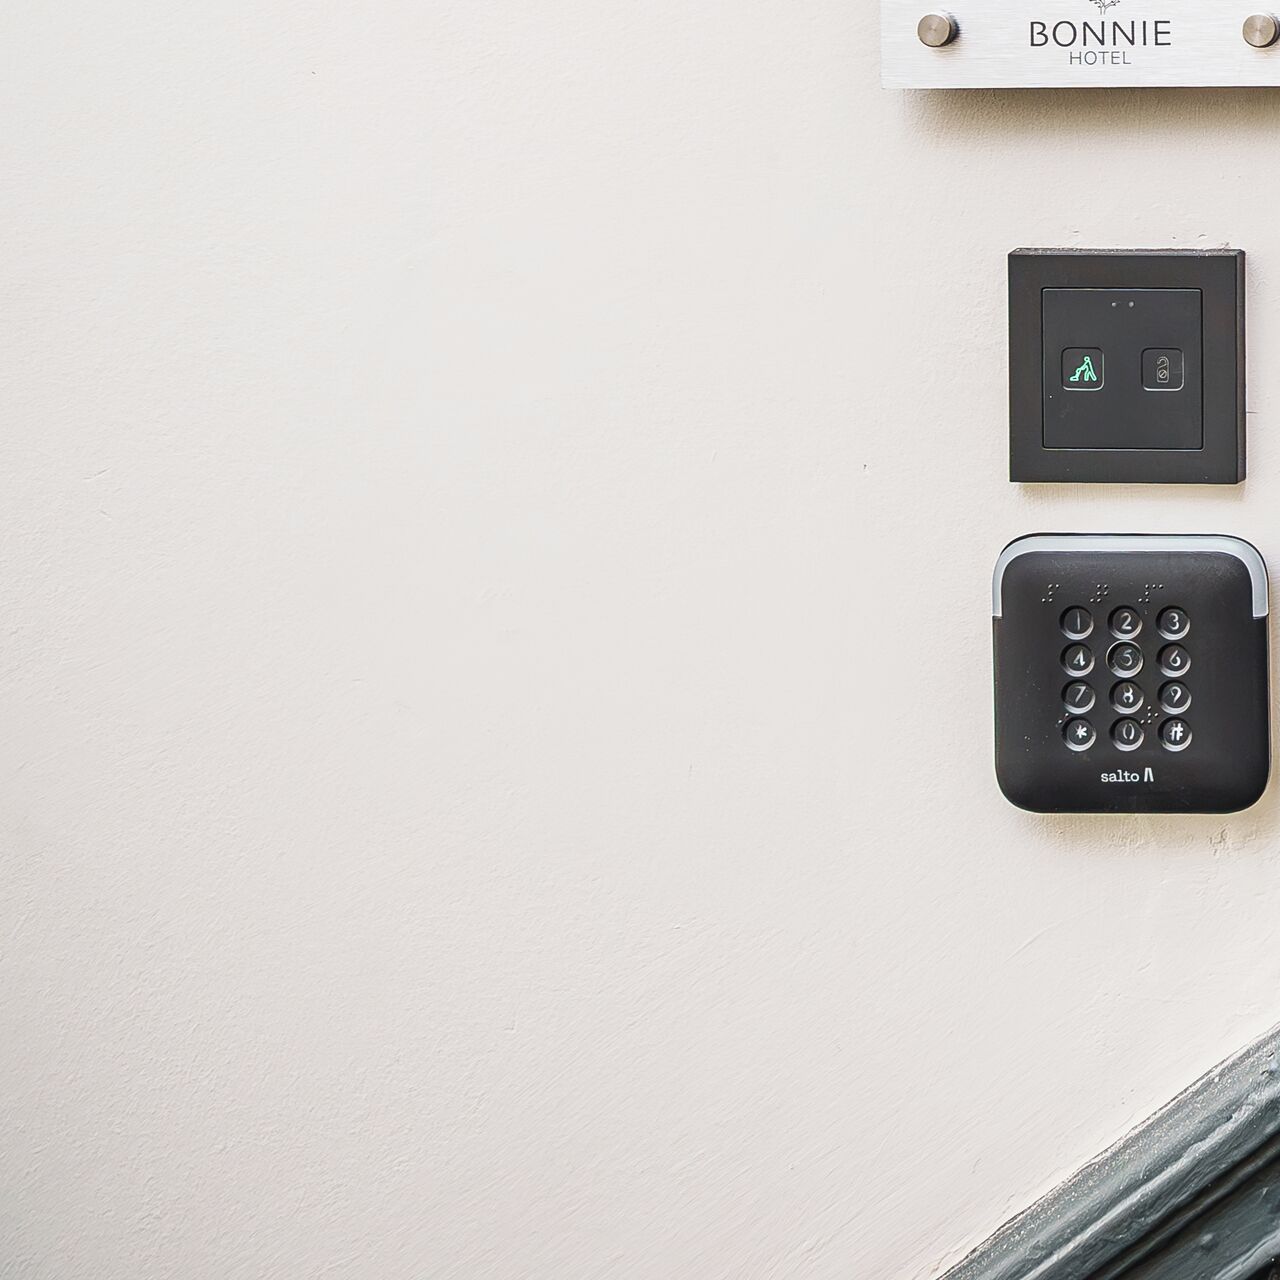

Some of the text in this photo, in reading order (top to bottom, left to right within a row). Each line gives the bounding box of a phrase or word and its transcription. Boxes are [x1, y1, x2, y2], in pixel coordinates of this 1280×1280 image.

[1029, 20, 1172, 47] BONNIE
[1069, 51, 1132, 65] HOTEL
[1121, 612, 1132, 630] 2
[1168, 612, 1180, 630] 3
[1124, 650, 1133, 667] 5
[1169, 650, 1181, 667] 6
[1074, 686, 1087, 703] 7
[1100, 769, 1140, 783] salto
